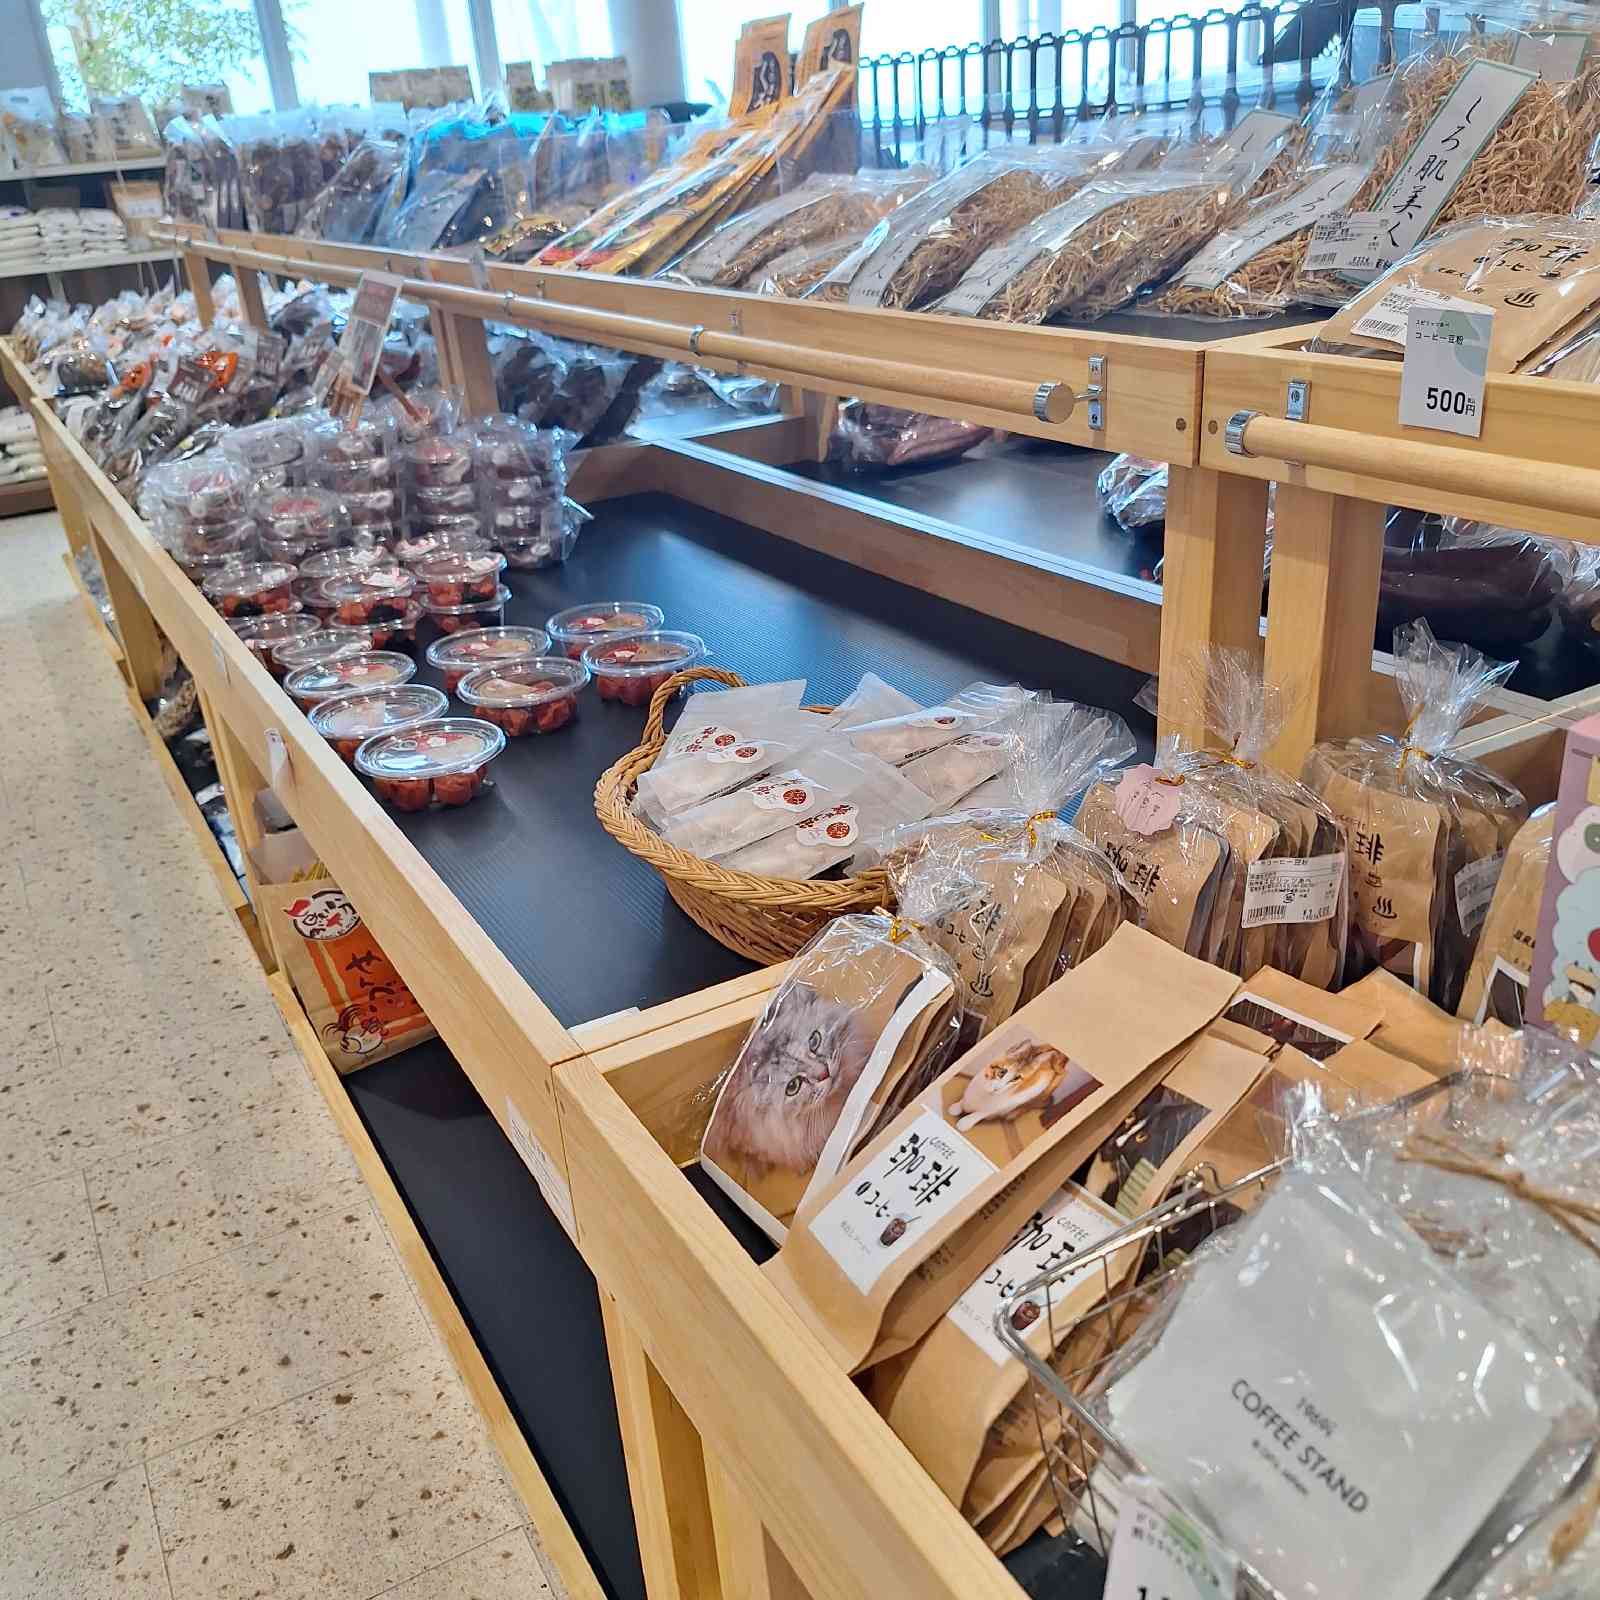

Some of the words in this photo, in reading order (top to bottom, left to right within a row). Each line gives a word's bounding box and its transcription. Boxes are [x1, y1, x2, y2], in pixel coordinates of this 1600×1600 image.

[1426, 387, 1476, 416] 500円
[883, 1133, 960, 1207] 珈琲
[984, 1268, 1014, 1298] コーヒ
[1231, 1379, 1301, 1450] COFFEE
[1296, 1445, 1368, 1512] STAND
